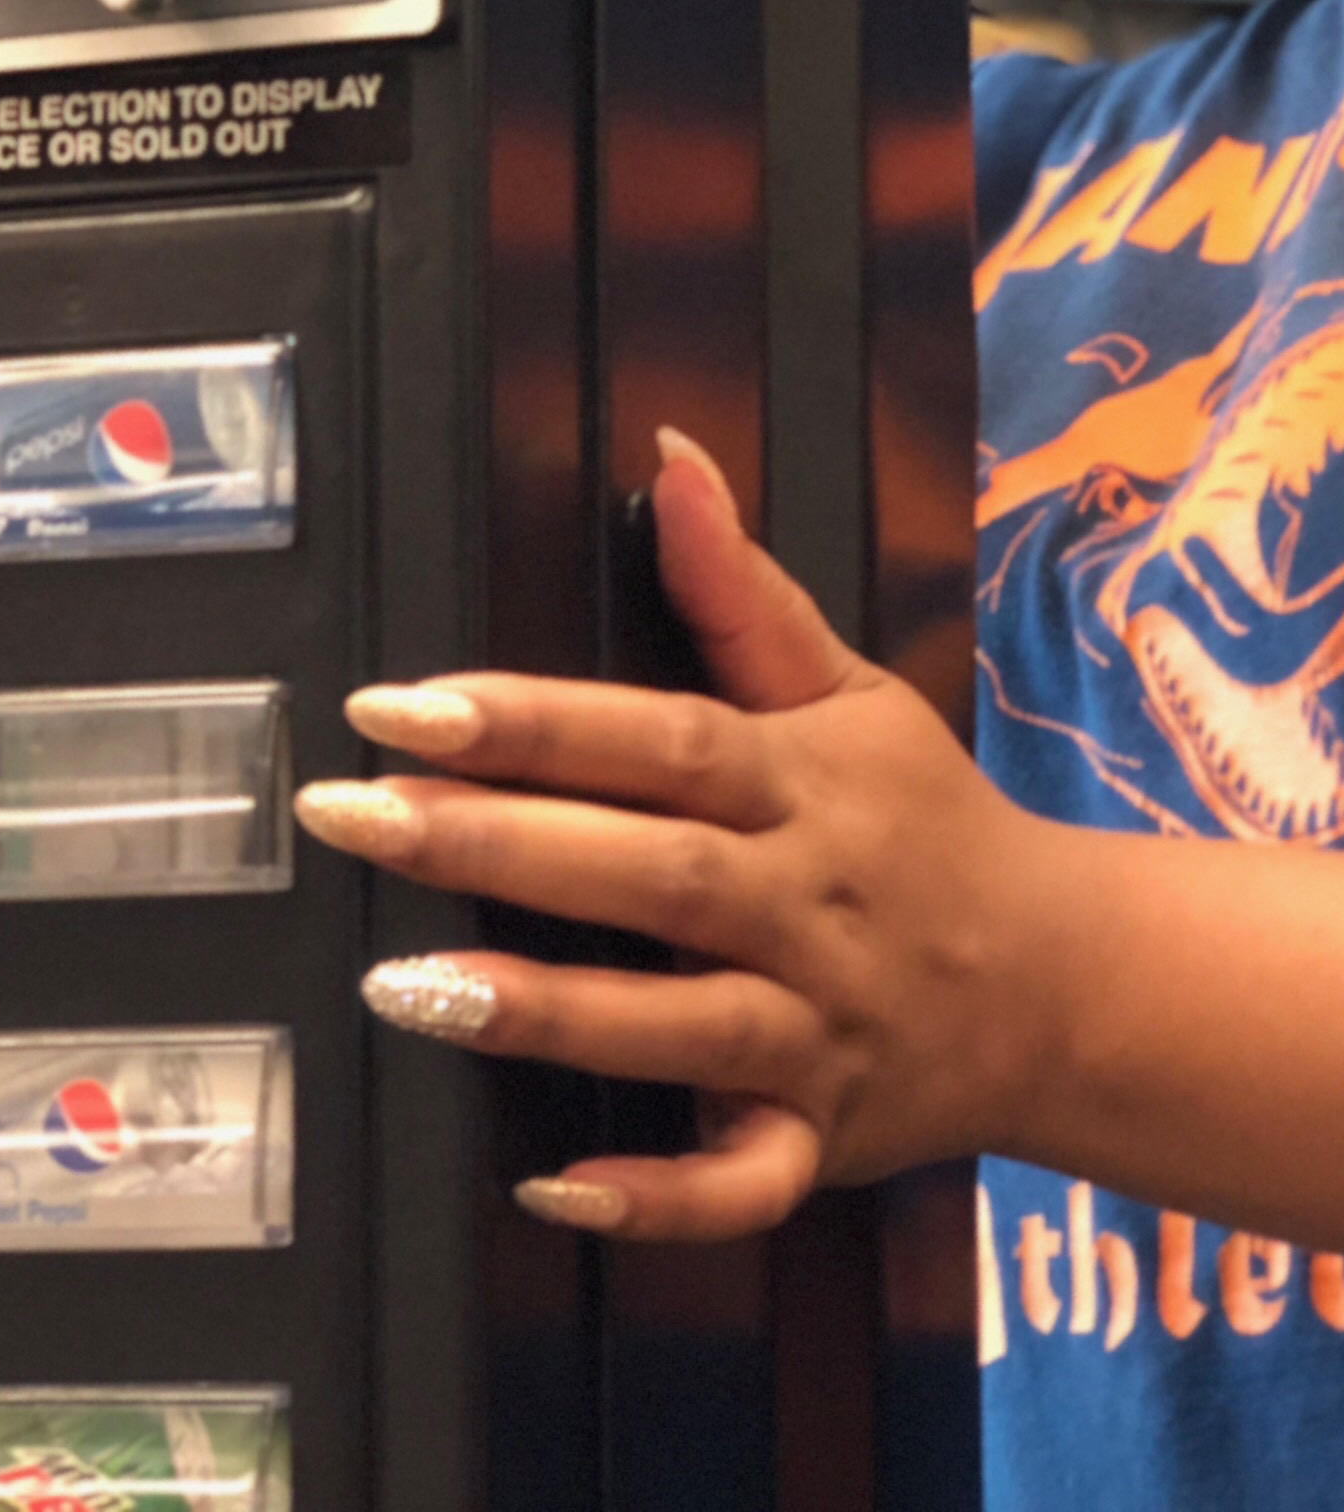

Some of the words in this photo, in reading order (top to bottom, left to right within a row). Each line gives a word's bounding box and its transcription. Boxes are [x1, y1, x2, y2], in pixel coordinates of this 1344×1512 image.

[174, 85, 225, 120] TO
[231, 74, 383, 115] DISPLAY
[48, 129, 102, 165] OR
[109, 122, 207, 161] SOLD
[215, 116, 293, 156] OUT
[26, 1198, 89, 1226] Pepsi
